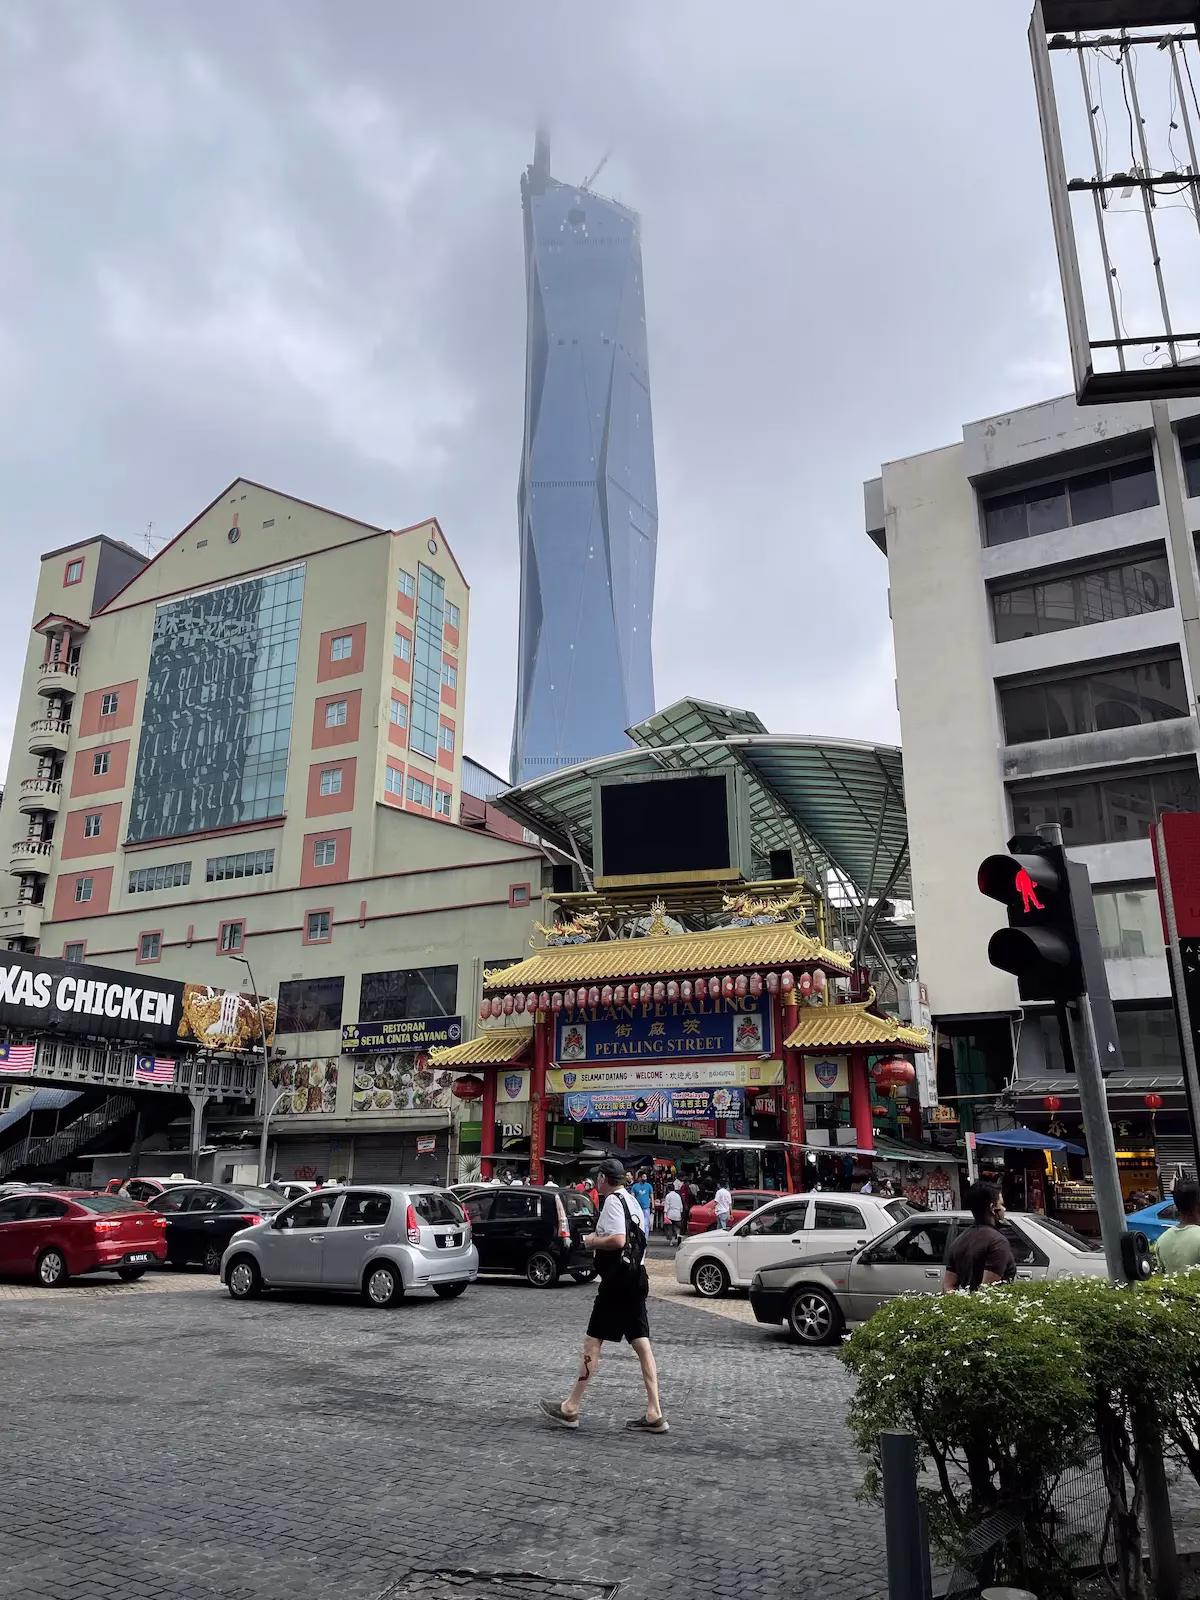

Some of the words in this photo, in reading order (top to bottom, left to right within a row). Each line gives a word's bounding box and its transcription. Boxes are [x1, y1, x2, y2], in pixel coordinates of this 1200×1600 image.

[56, 976, 175, 1026] CHICKEN
[565, 1003, 634, 1023] JALAN
[641, 995, 757, 1018] PETALING
[382, 1022, 426, 1034] RESTORAN
[360, 1035, 385, 1046] SETIA
[386, 1033, 411, 1044] CINTA
[412, 1030, 447, 1042] SAYANG
[595, 1040, 663, 1056] PETALING
[667, 1037, 724, 1052] STREET
[581, 1073, 605, 1082] SELAMAT
[606, 1072, 628, 1081] DATANG
[636, 1071, 663, 1080] WELCOME
[685, 1091, 709, 1099] Malaysia
[673, 1099, 708, 1108] 马来西亚日
